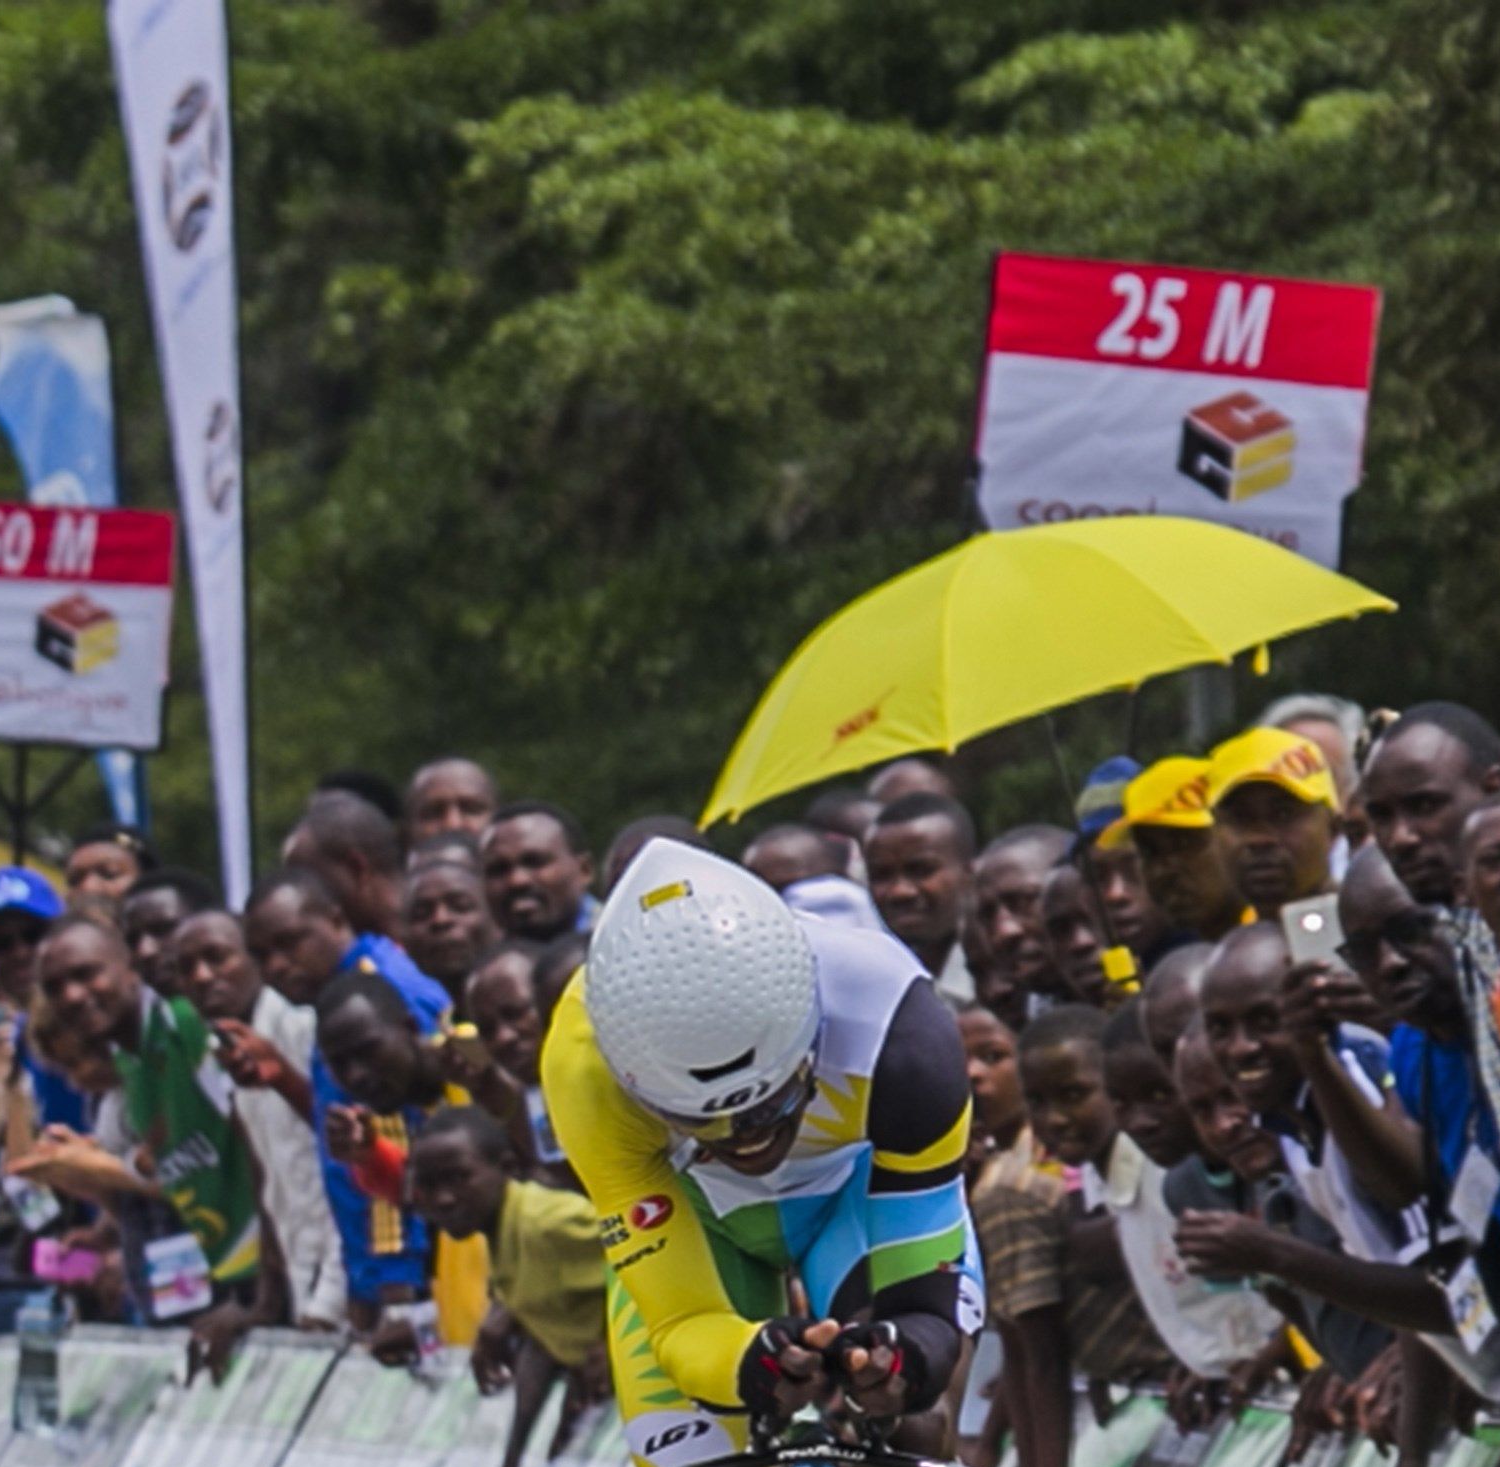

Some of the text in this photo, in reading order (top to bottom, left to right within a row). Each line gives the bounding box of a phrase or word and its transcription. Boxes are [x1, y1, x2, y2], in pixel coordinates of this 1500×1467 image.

[1095, 272, 1275, 369] 25 M
[46, 511, 100, 577] M
[645, 1424, 689, 1456] LG
